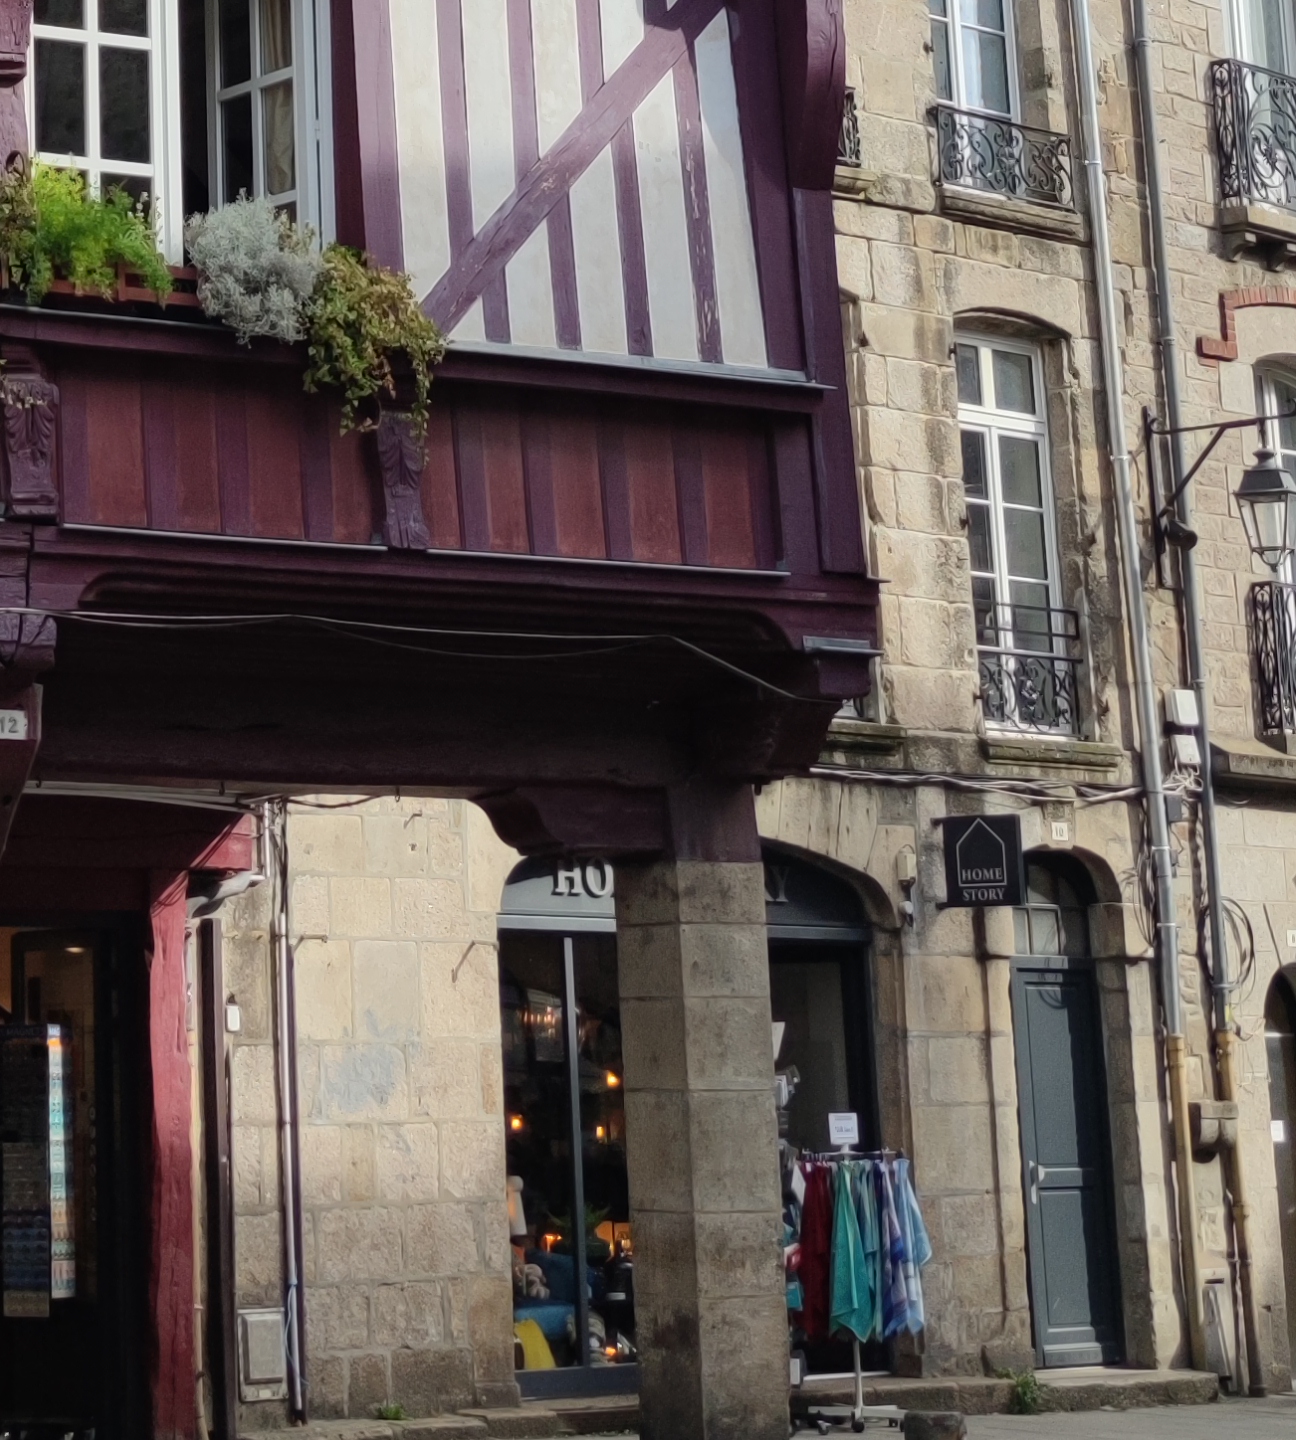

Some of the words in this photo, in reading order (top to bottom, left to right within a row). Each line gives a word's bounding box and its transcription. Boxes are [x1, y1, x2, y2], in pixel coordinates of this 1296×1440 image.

[0, 716, 19, 734] 12
[1054, 824, 1065, 838] 10
[554, 857, 614, 897] HO
[961, 867, 1003, 882] HOME
[962, 887, 1005, 902] STORY
